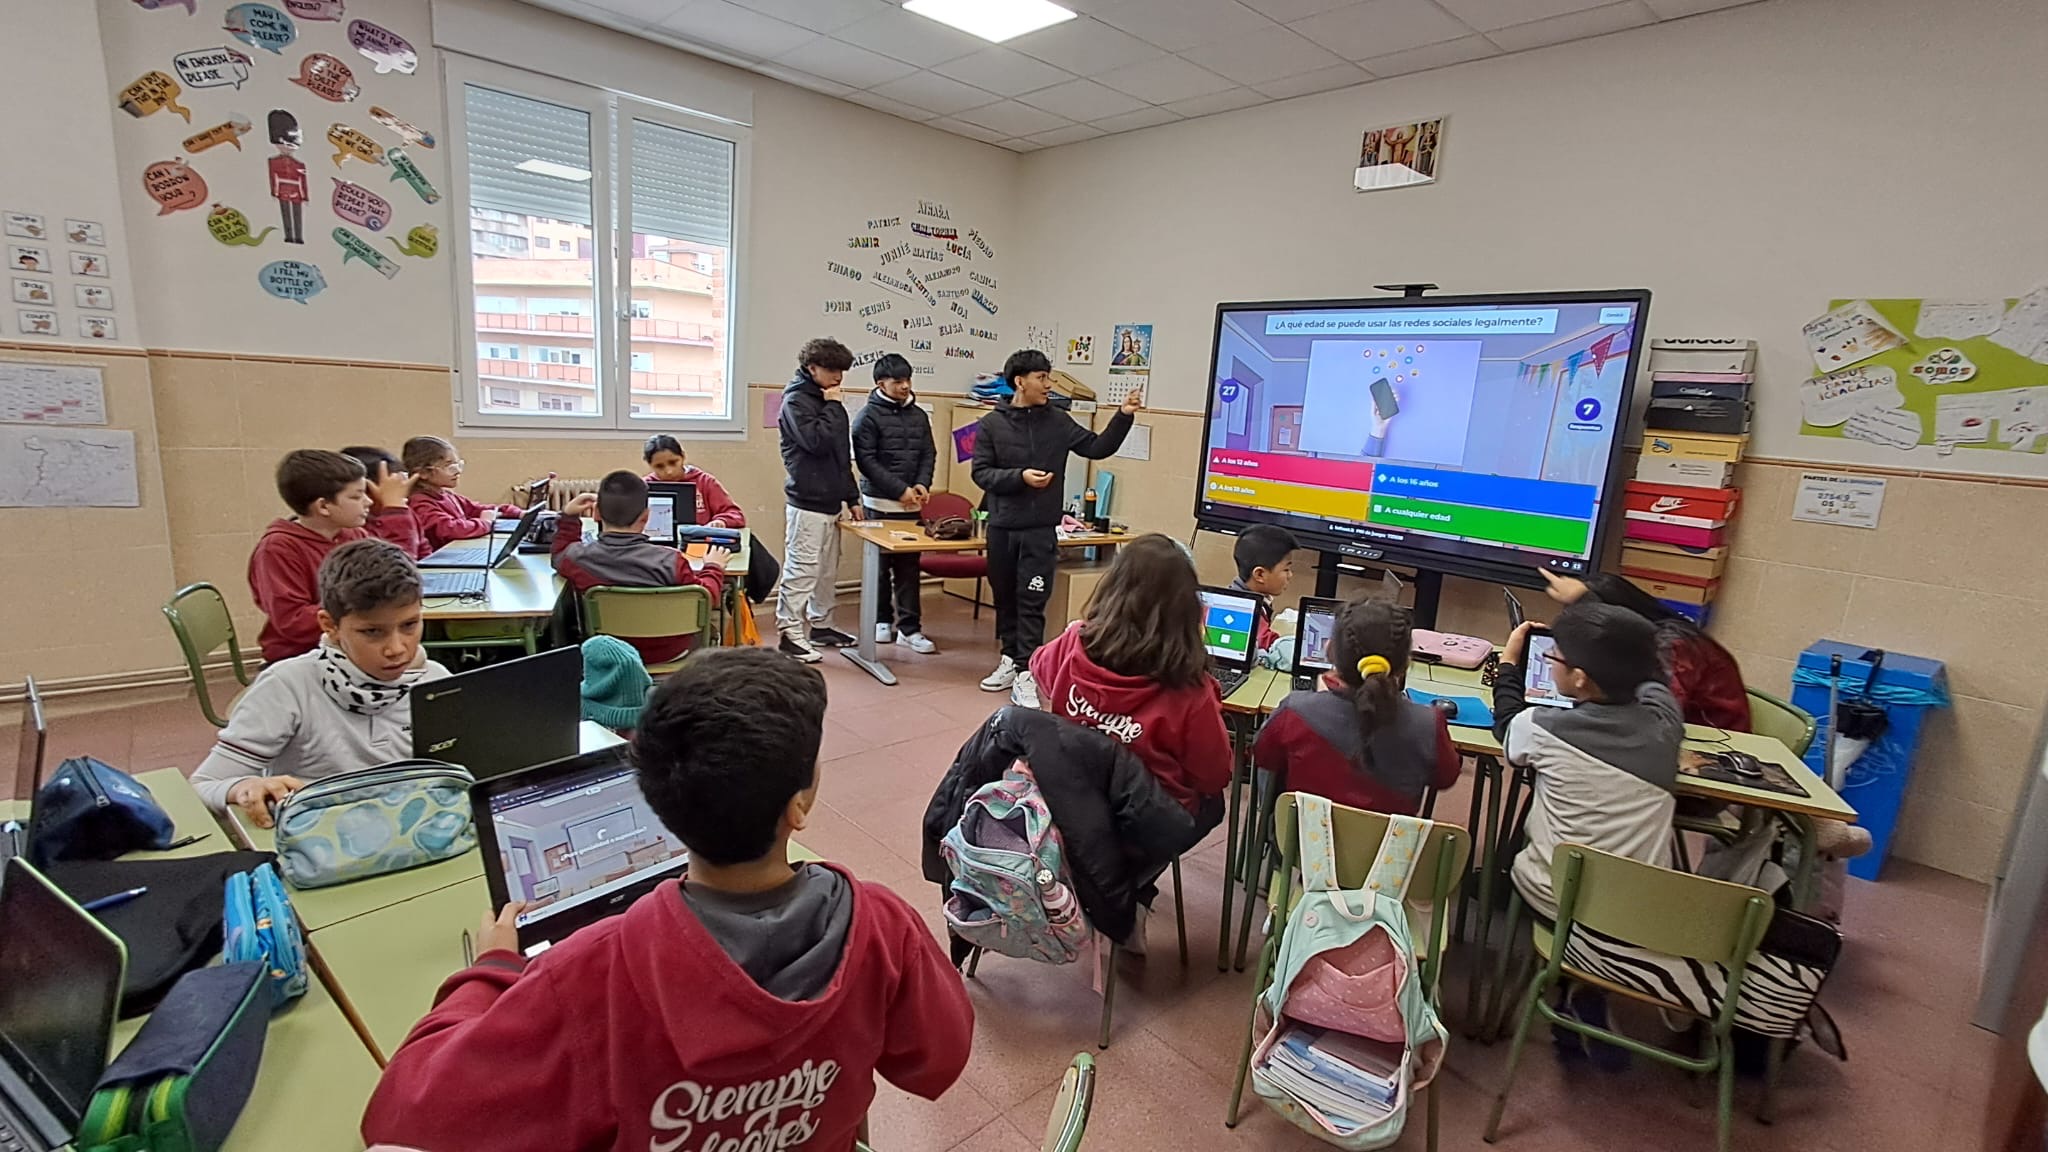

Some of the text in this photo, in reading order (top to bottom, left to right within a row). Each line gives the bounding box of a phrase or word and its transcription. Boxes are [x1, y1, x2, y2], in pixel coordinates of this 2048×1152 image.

[253, 8, 273, 20] MAY
[250, 18, 290, 33] COME IN
[252, 30, 290, 43] PLEASE?
[177, 54, 229, 69] IN ENGLISH
[307, 79, 343, 98] PLEASE?
[147, 168, 165, 181] CAN
[151, 175, 190, 192] BORROW
[159, 188, 184, 201] YOUR
[340, 184, 366, 200] COULD
[337, 192, 366, 208] REPEAT
[335, 200, 367, 216] PLEASE?
[848, 237, 880, 248] SAMIR
[280, 267, 293, 276] FILL
[283, 261, 300, 269] CAN
[827, 260, 862, 281] THIAGO
[270, 276, 300, 286] BOTTLE
[825, 301, 852, 313] JOHN
[950, 302, 968, 319] NOA
[903, 316, 933, 329] PAULA
[1287, 321, 1301, 330] qué
[1304, 319, 1325, 328] edad
[1337, 319, 1366, 329] puede
[1389, 319, 1402, 327] las
[1404, 318, 1430, 327] redes
[1432, 317, 1472, 327] sociales
[1475, 316, 1543, 328] legalmente?
[1222, 386, 1236, 396] 27
[1583, 404, 1594, 415] 7
[1419, 480, 1439, 488] años
[1392, 508, 1429, 518] cualquier
[1429, 513, 1451, 522] edad
[428, 738, 457, 753] acer
[650, 1058, 841, 1152] Siempre
[684, 1110, 821, 1152] legres
